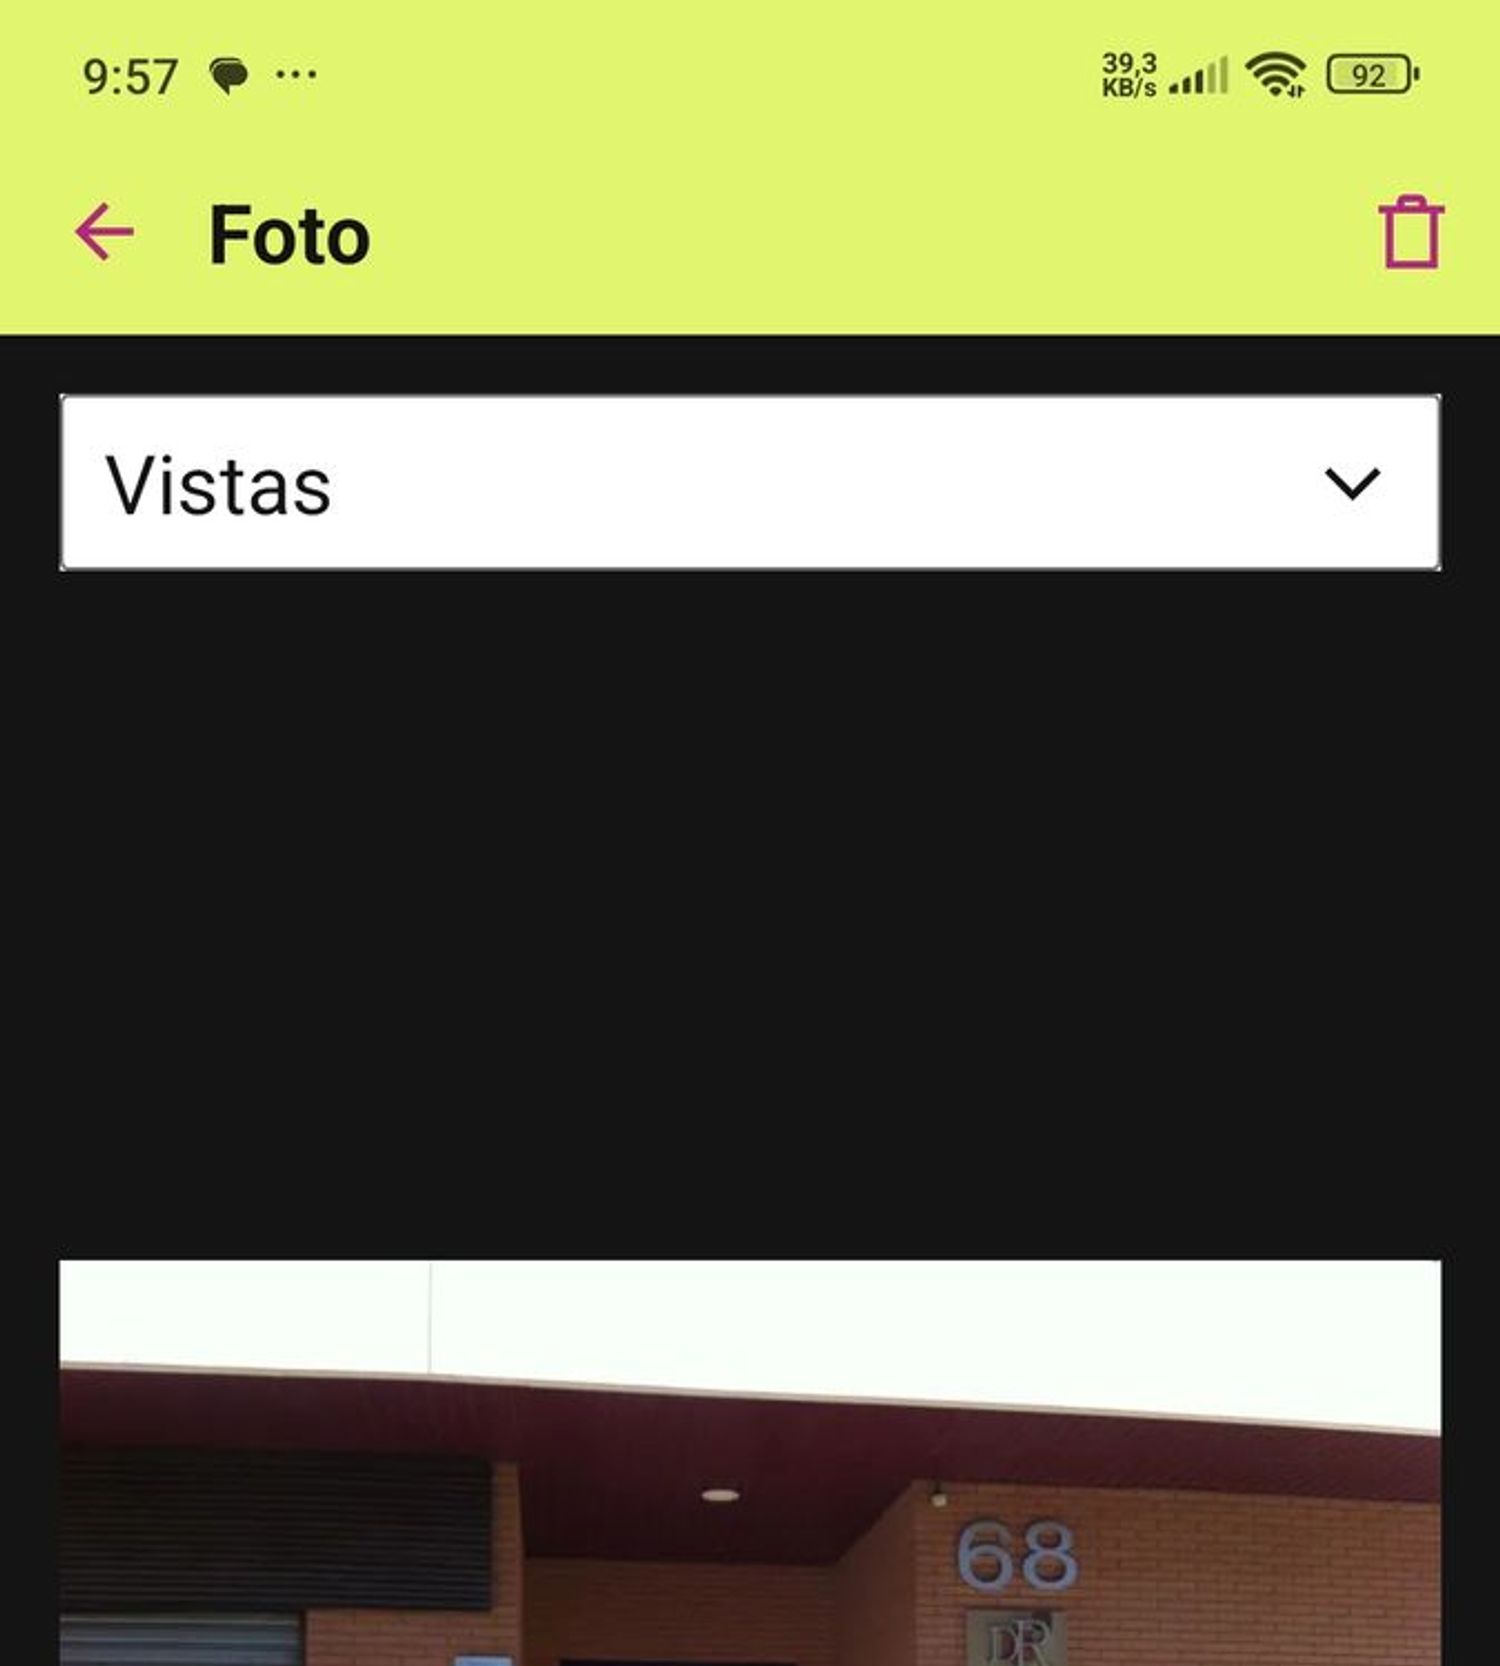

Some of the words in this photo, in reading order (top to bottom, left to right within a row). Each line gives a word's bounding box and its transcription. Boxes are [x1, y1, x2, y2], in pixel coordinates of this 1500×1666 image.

[84, 58, 178, 95] 9:57
[1103, 52, 1157, 77] 39,3
[1352, 64, 1385, 88] 92
[1102, 77, 1157, 99] KB/s
[211, 203, 370, 266] Foto
[106, 454, 331, 516] Vistas
[957, 1518, 1079, 1593] 68
